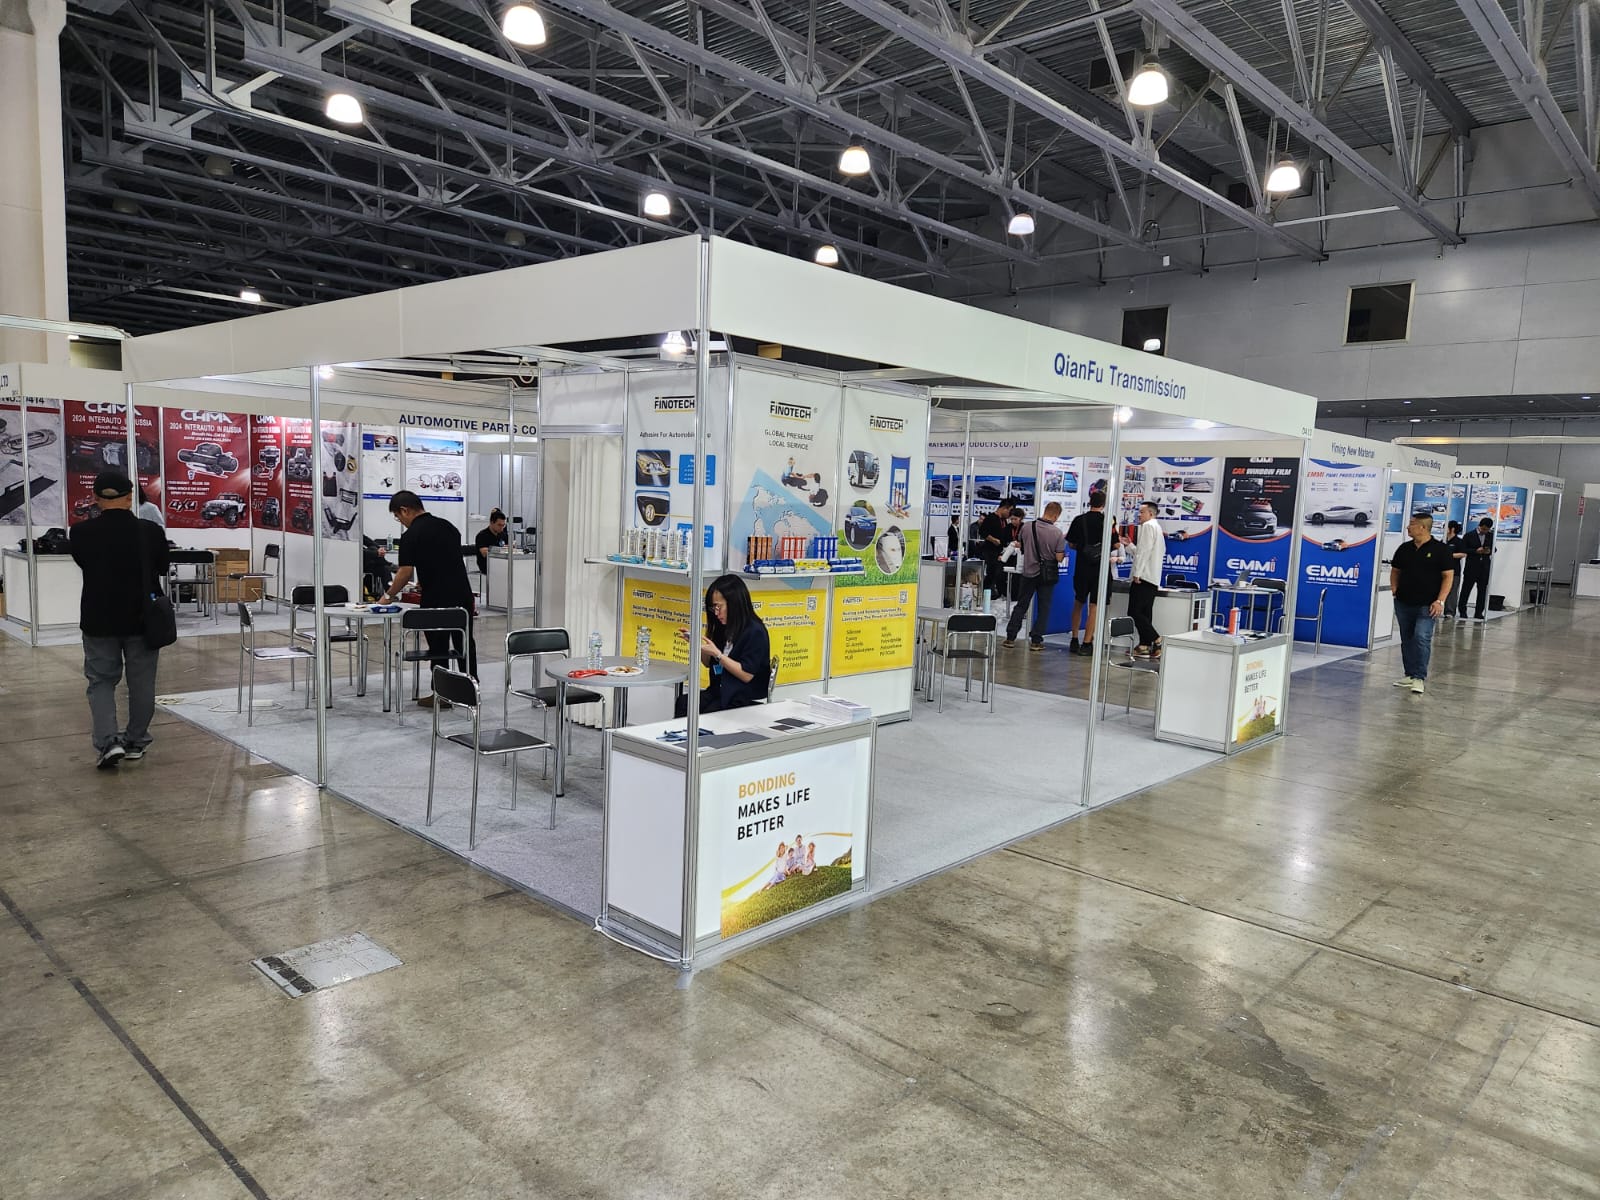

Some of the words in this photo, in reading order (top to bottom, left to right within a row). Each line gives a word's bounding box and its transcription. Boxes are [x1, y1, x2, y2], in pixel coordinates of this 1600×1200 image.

[1054, 352, 1104, 383] QianFu
[1109, 364, 1186, 400] Transmission
[654, 399, 695, 410] FINOTECH
[769, 404, 812, 419] FINOTECH
[88, 415, 122, 425] INTERAUTO
[136, 418, 153, 427] USSIA
[399, 414, 478, 431] AUTOMOTIVE
[482, 421, 518, 434] PARTS
[869, 418, 904, 430] FINOTECH
[184, 423, 215, 432] INTERAUTO
[764, 429, 785, 438] GLOBAL
[769, 440, 785, 448] LOCAL
[787, 441, 809, 451] SERVICE
[1275, 468, 1292, 476] FILM
[738, 771, 796, 799] BONDING
[738, 795, 780, 820] MAKES
[786, 787, 811, 807] LIFE
[737, 814, 785, 841] BETTER
